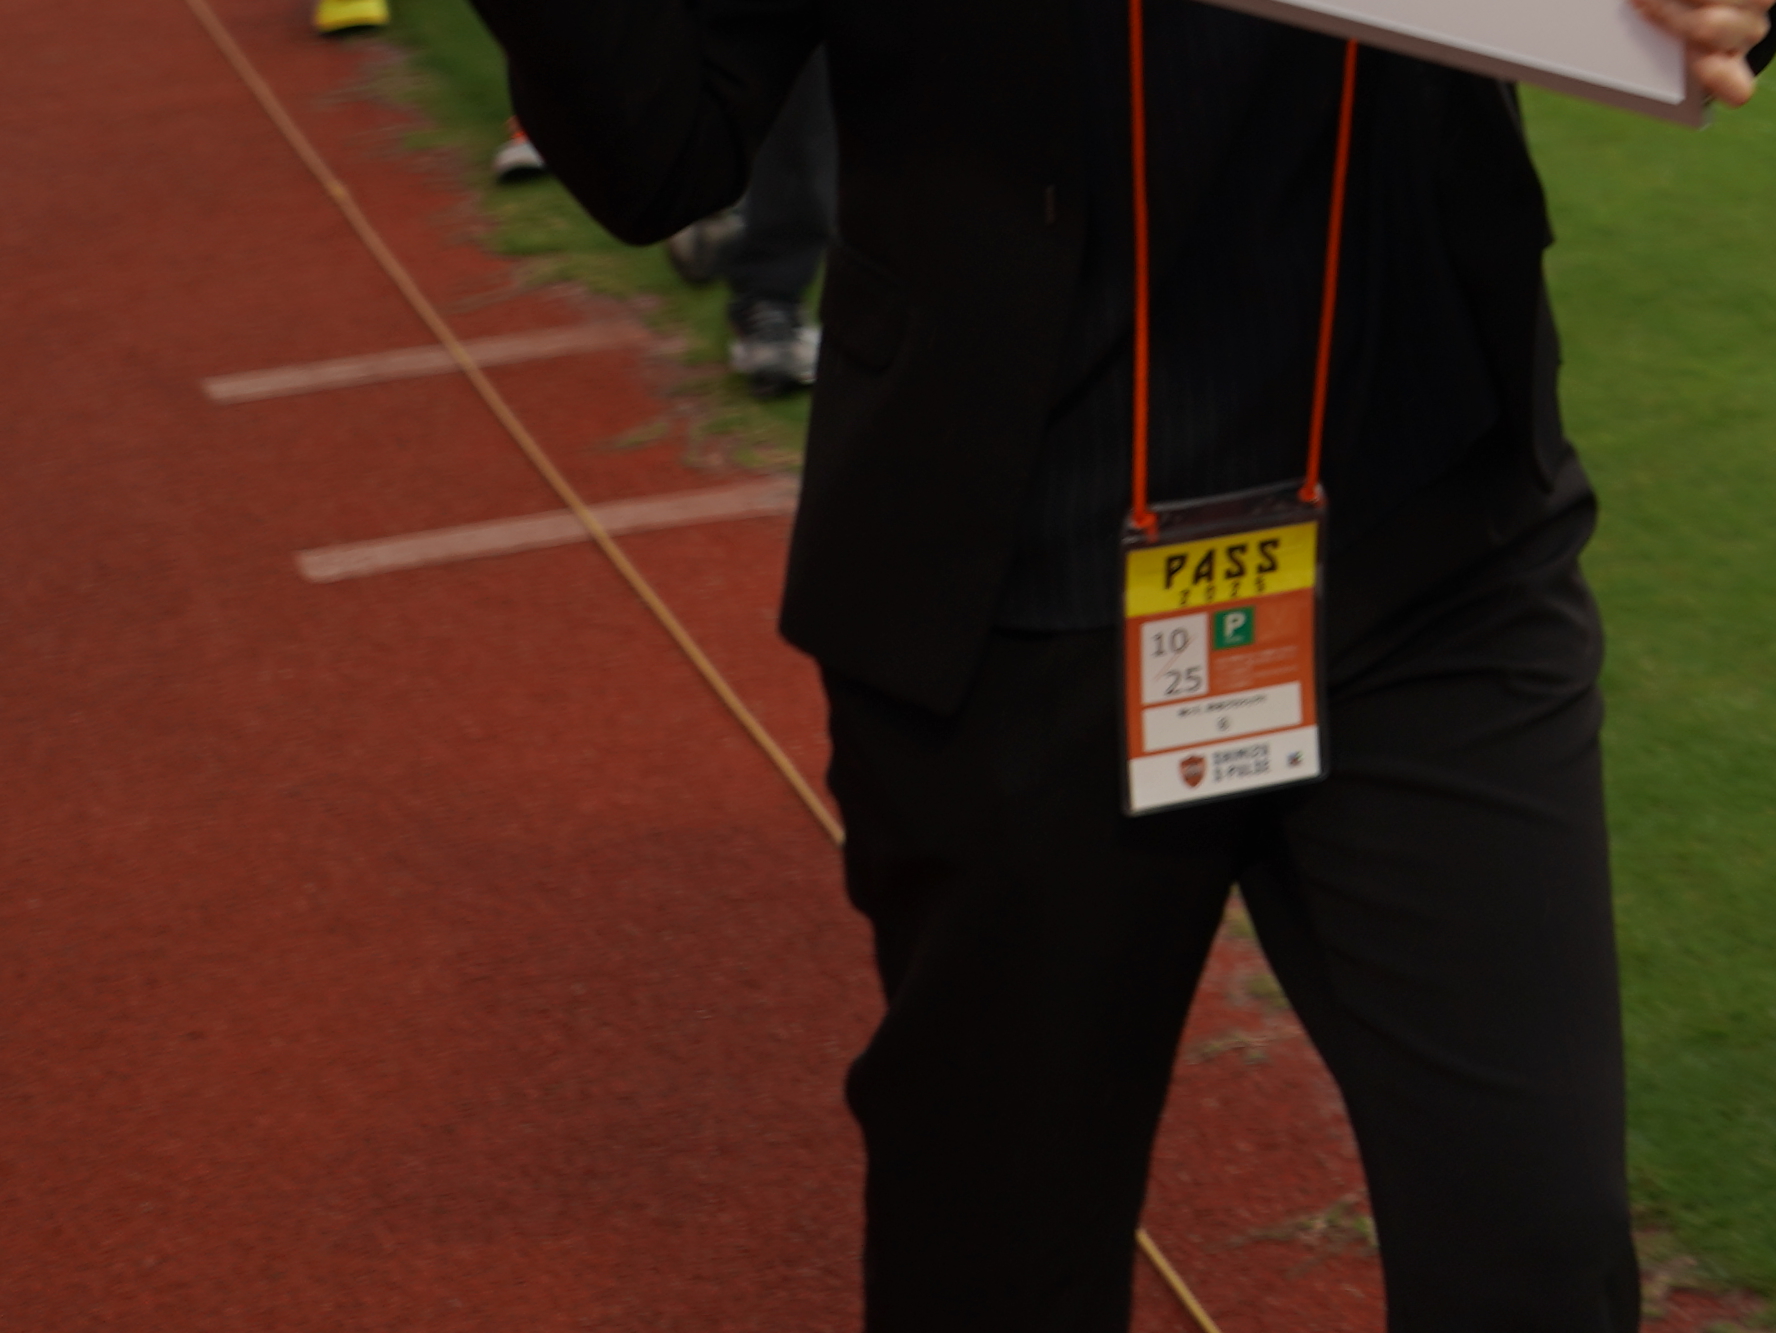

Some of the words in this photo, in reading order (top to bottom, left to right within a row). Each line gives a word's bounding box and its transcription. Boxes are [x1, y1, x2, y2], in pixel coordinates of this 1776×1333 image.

[1164, 537, 1281, 591] PASS
[1150, 626, 1191, 659] 10
[1223, 613, 1246, 638] P
[1163, 665, 1204, 697] 25
